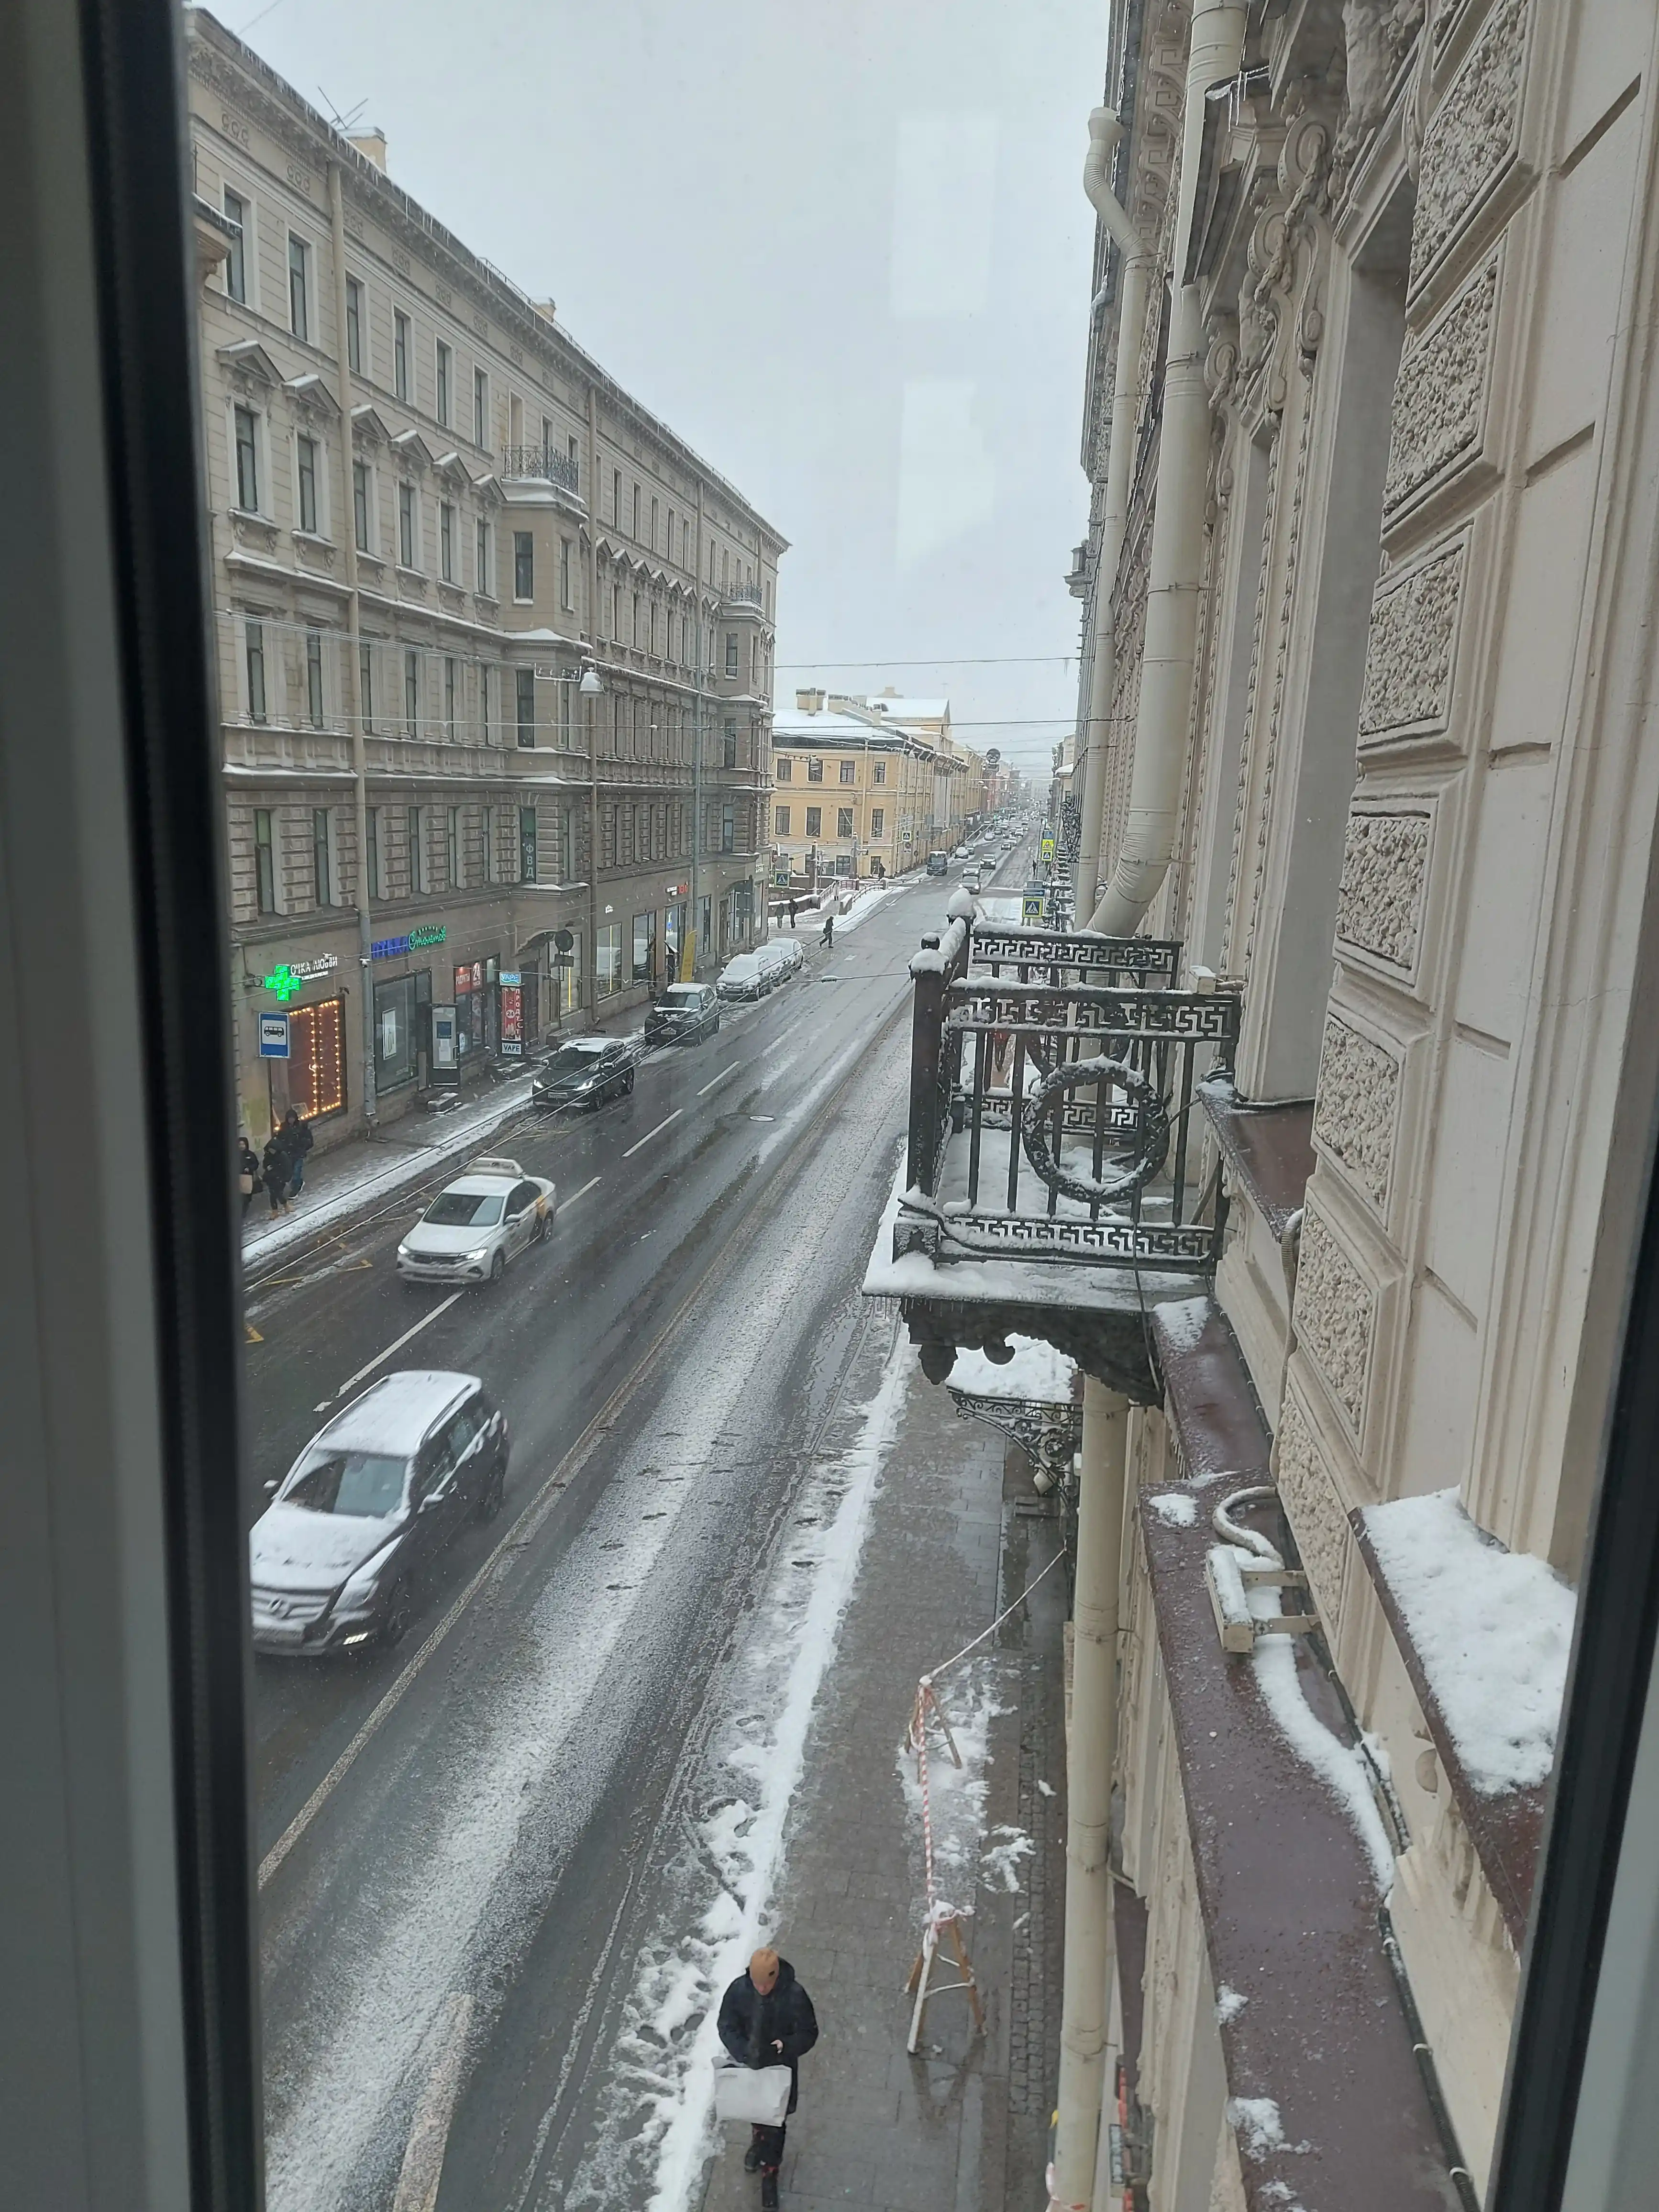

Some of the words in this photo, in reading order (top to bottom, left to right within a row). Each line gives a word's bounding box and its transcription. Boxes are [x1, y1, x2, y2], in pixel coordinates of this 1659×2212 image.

[526, 844, 534, 878] ФВД
[372, 936, 410, 959] ПТЕКА
[290, 961, 310, 975] ОЧКА
[473, 962, 480, 981] 24
